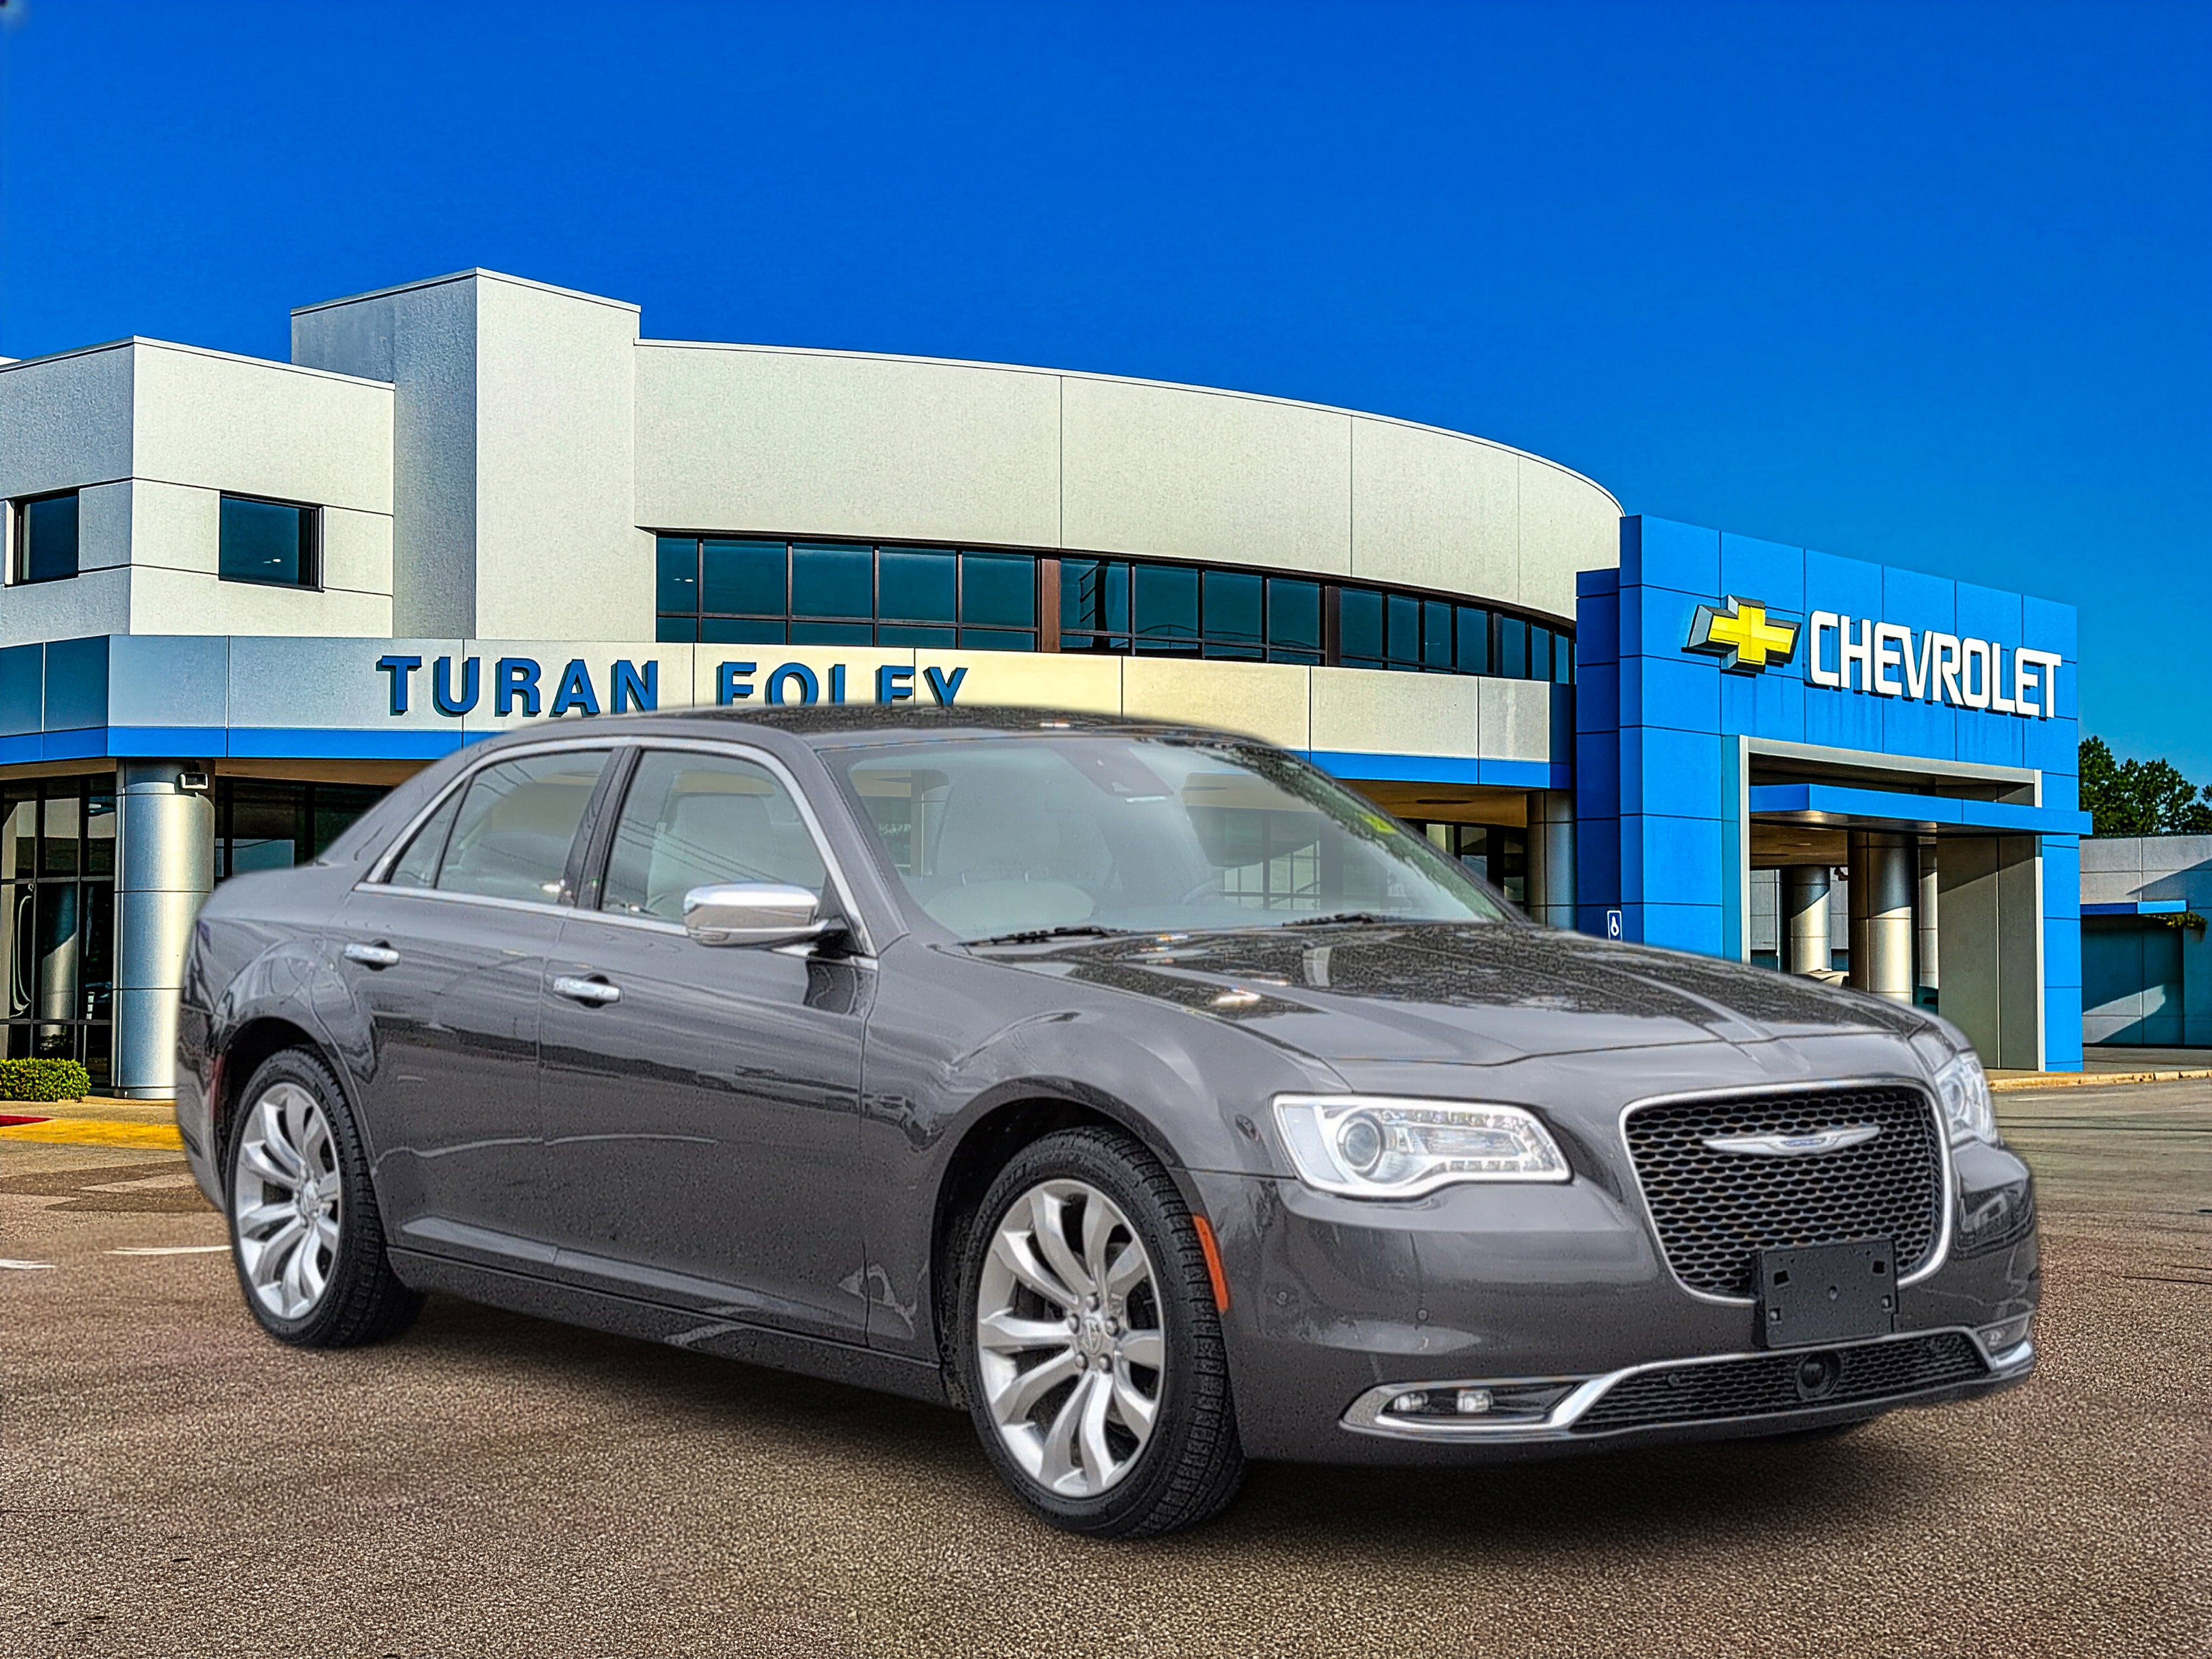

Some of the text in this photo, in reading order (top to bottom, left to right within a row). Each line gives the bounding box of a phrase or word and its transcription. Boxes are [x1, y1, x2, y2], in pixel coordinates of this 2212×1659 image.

[376, 655, 969, 717] TURAN FOLEY
[1810, 609, 2062, 719] CHEVROLET
